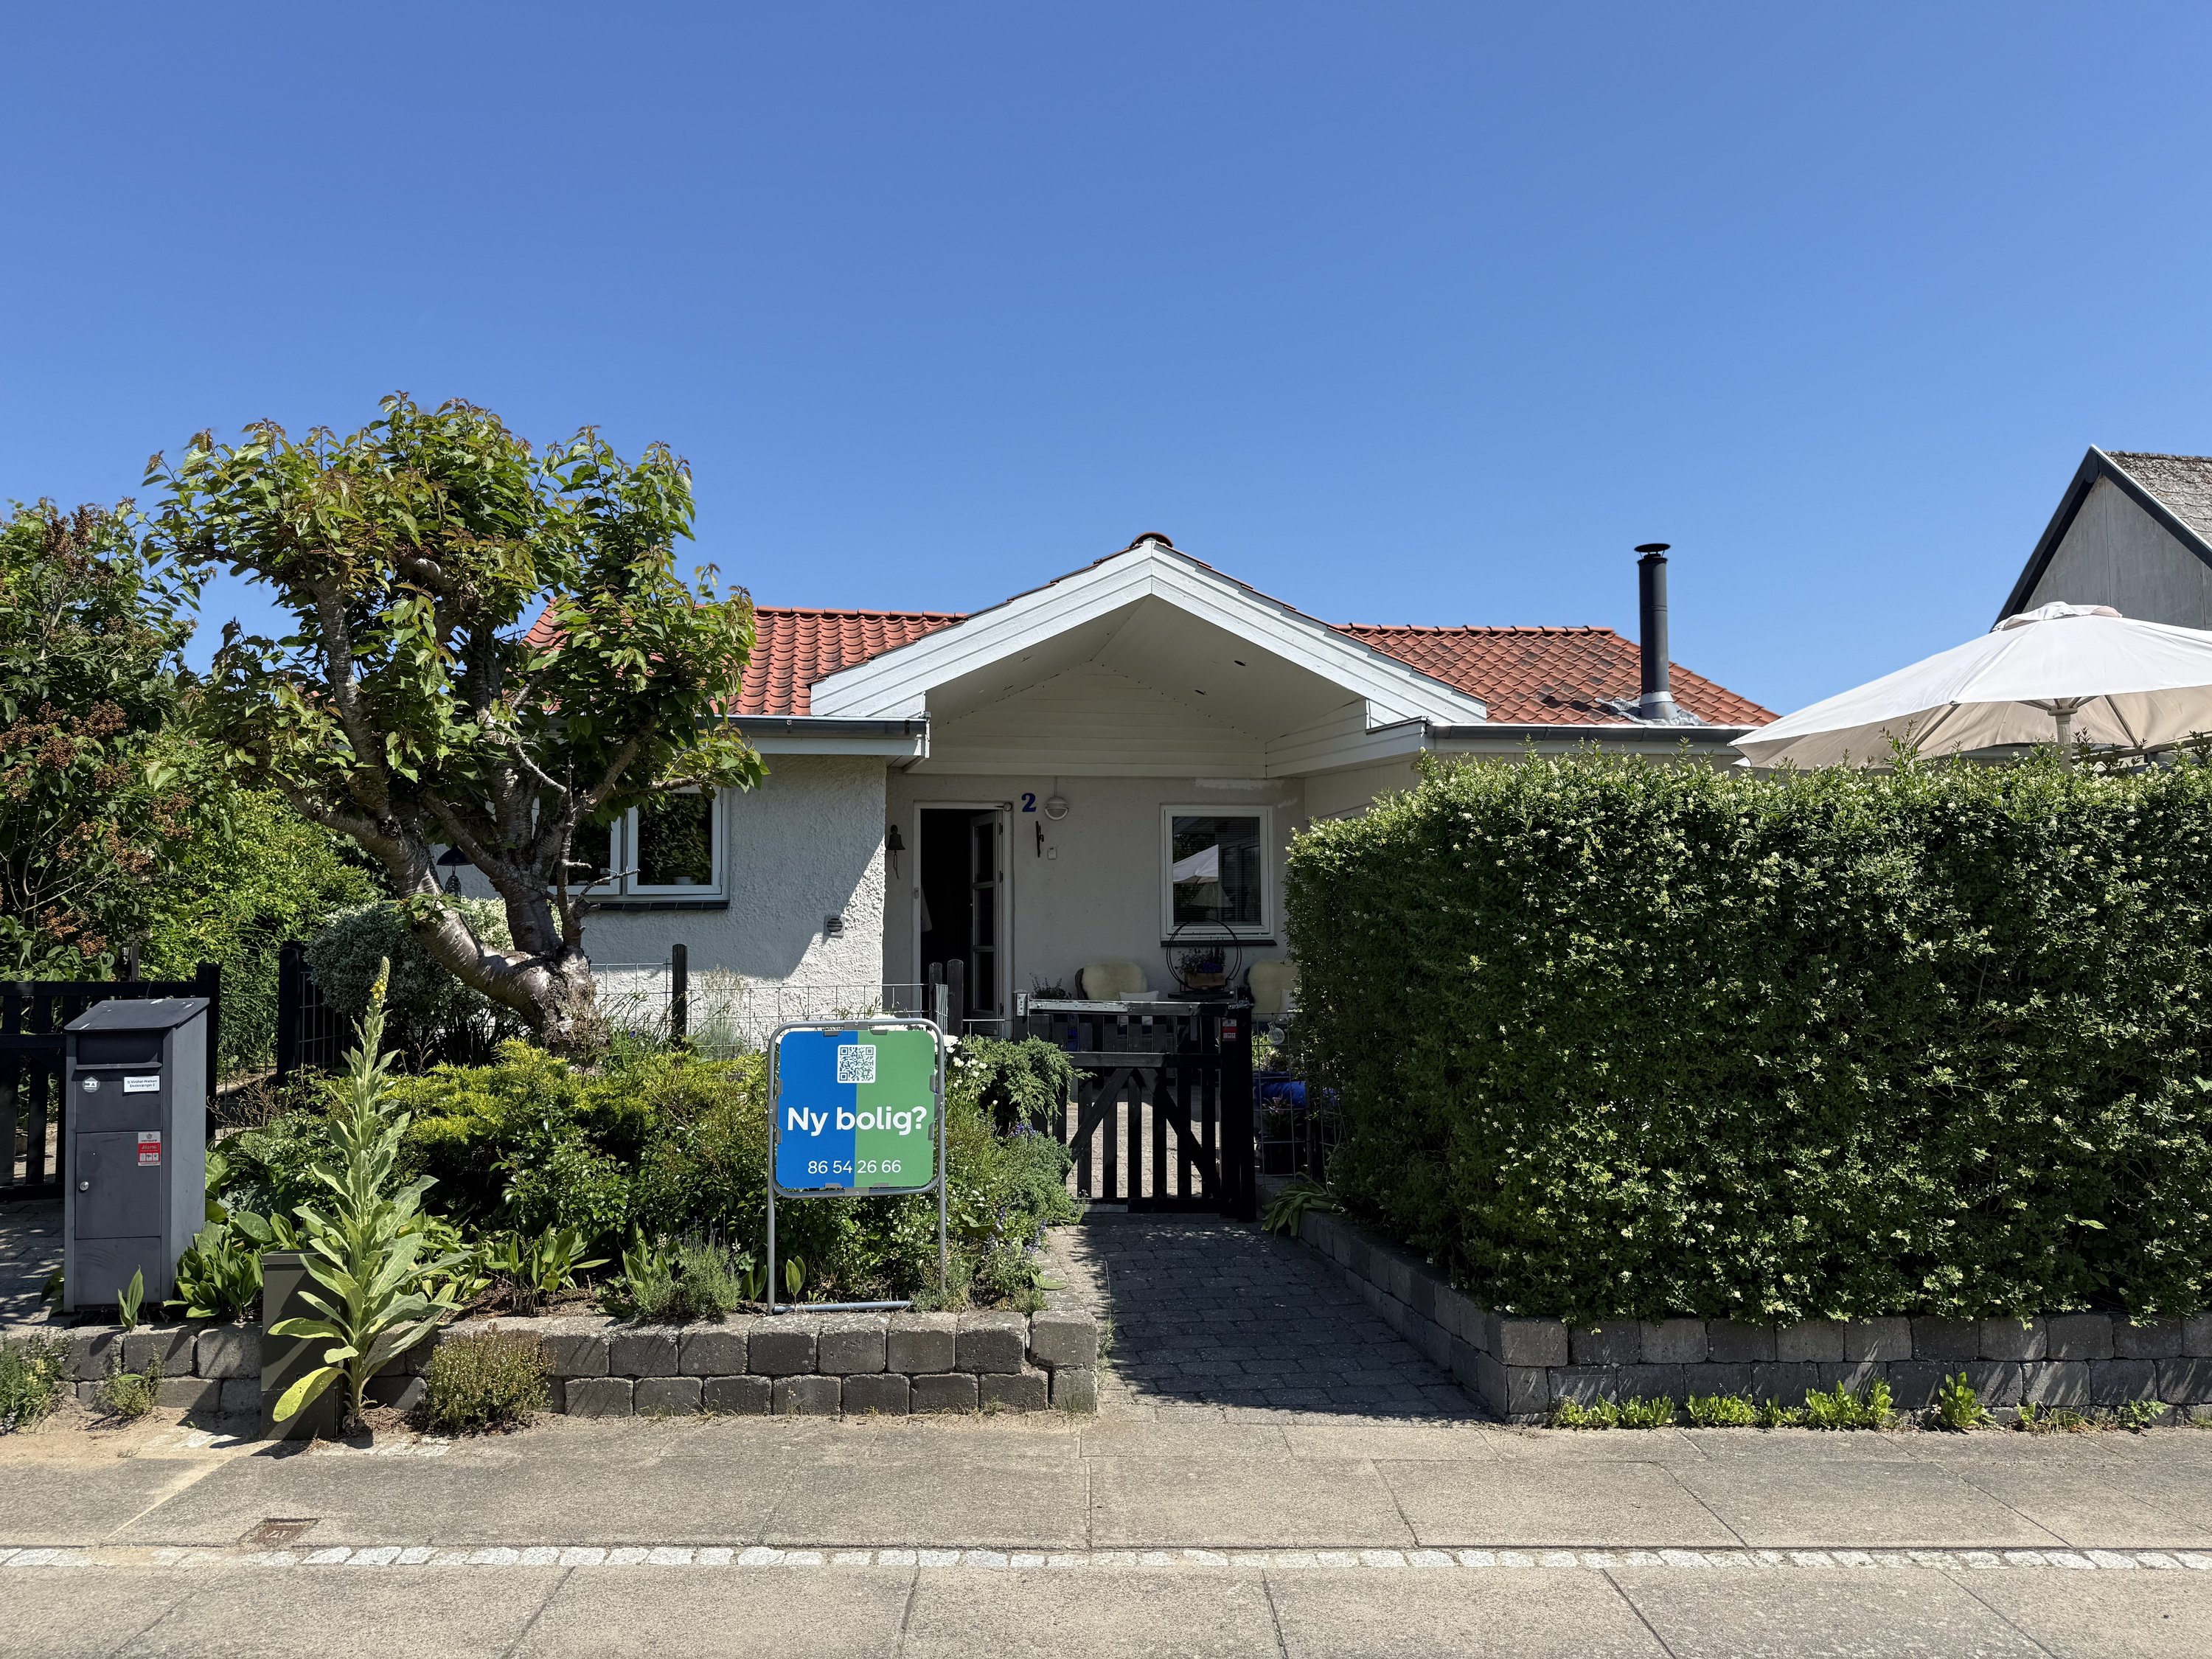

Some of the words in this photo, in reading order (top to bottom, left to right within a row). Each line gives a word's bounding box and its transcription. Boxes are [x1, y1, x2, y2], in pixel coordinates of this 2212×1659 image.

[1021, 792, 1037, 813] 2
[787, 1107, 829, 1137] Ny
[836, 1106, 928, 1136] bolig?
[807, 1160, 828, 1174] 86
[832, 1160, 853, 1174] 54
[857, 1160, 877, 1173] 26
[881, 1159, 902, 1173] 66
